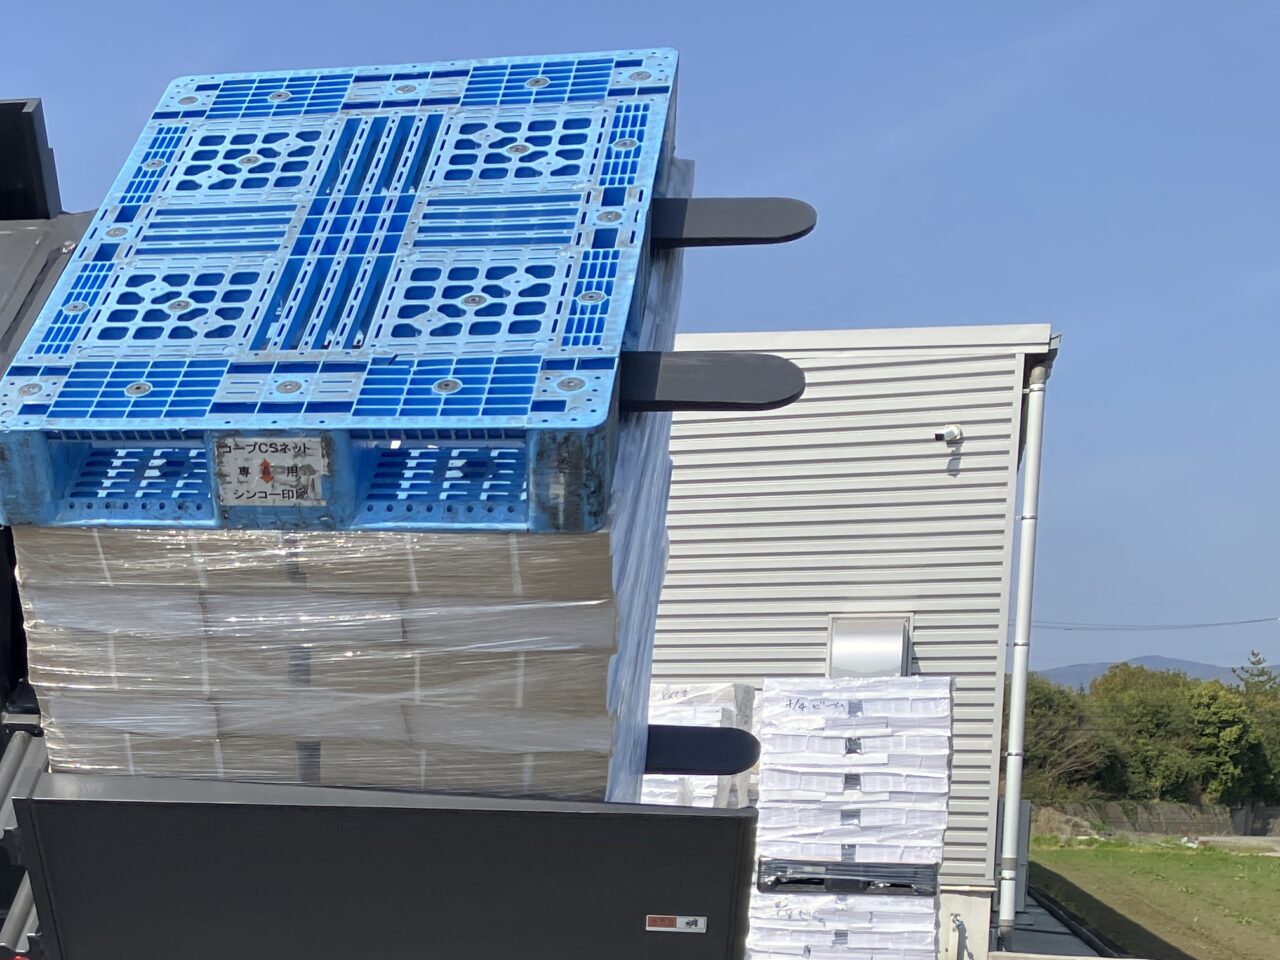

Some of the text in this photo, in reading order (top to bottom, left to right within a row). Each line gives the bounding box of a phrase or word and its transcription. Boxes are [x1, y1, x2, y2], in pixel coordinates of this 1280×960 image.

[222, 442, 310, 455] コープCSネット
